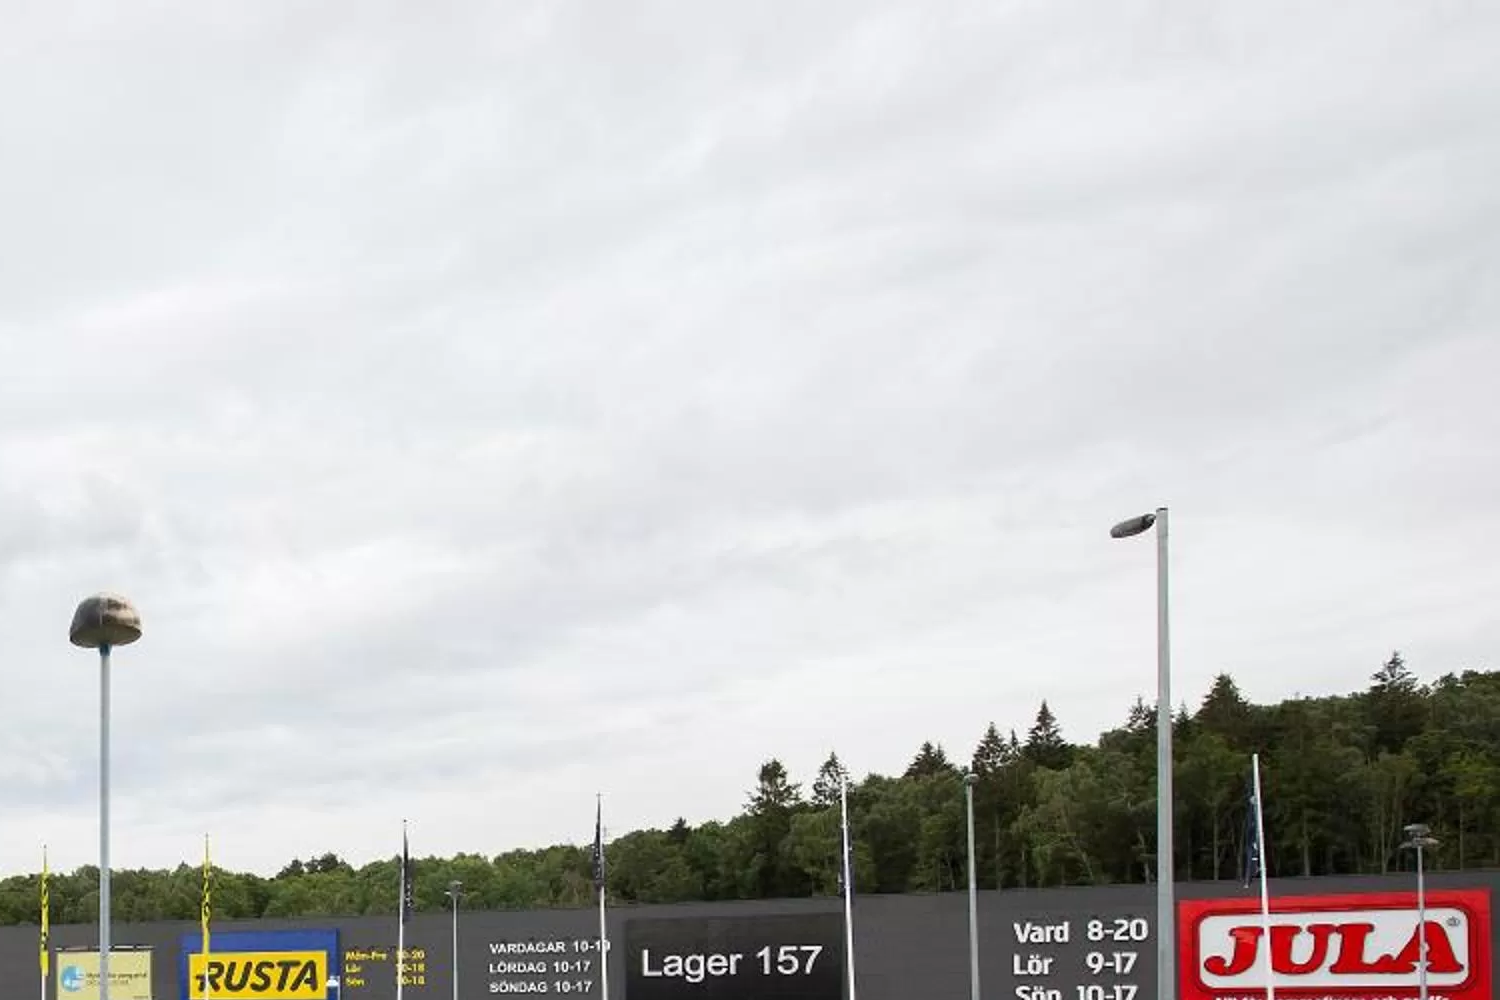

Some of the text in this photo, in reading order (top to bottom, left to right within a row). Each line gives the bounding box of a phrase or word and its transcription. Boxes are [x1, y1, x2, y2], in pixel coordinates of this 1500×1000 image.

[1013, 919, 1149, 943] Vard 8-20
[489, 941, 566, 954] VARDAGAR
[1203, 920, 1465, 977] JULA
[489, 960, 591, 973] LÖRDAG 10-17
[642, 945, 823, 983] Lager 157
[1013, 951, 1138, 975] Lör 9-17
[195, 960, 318, 992] RUSTA
[489, 980, 593, 993] SÖNDAG 10-17
